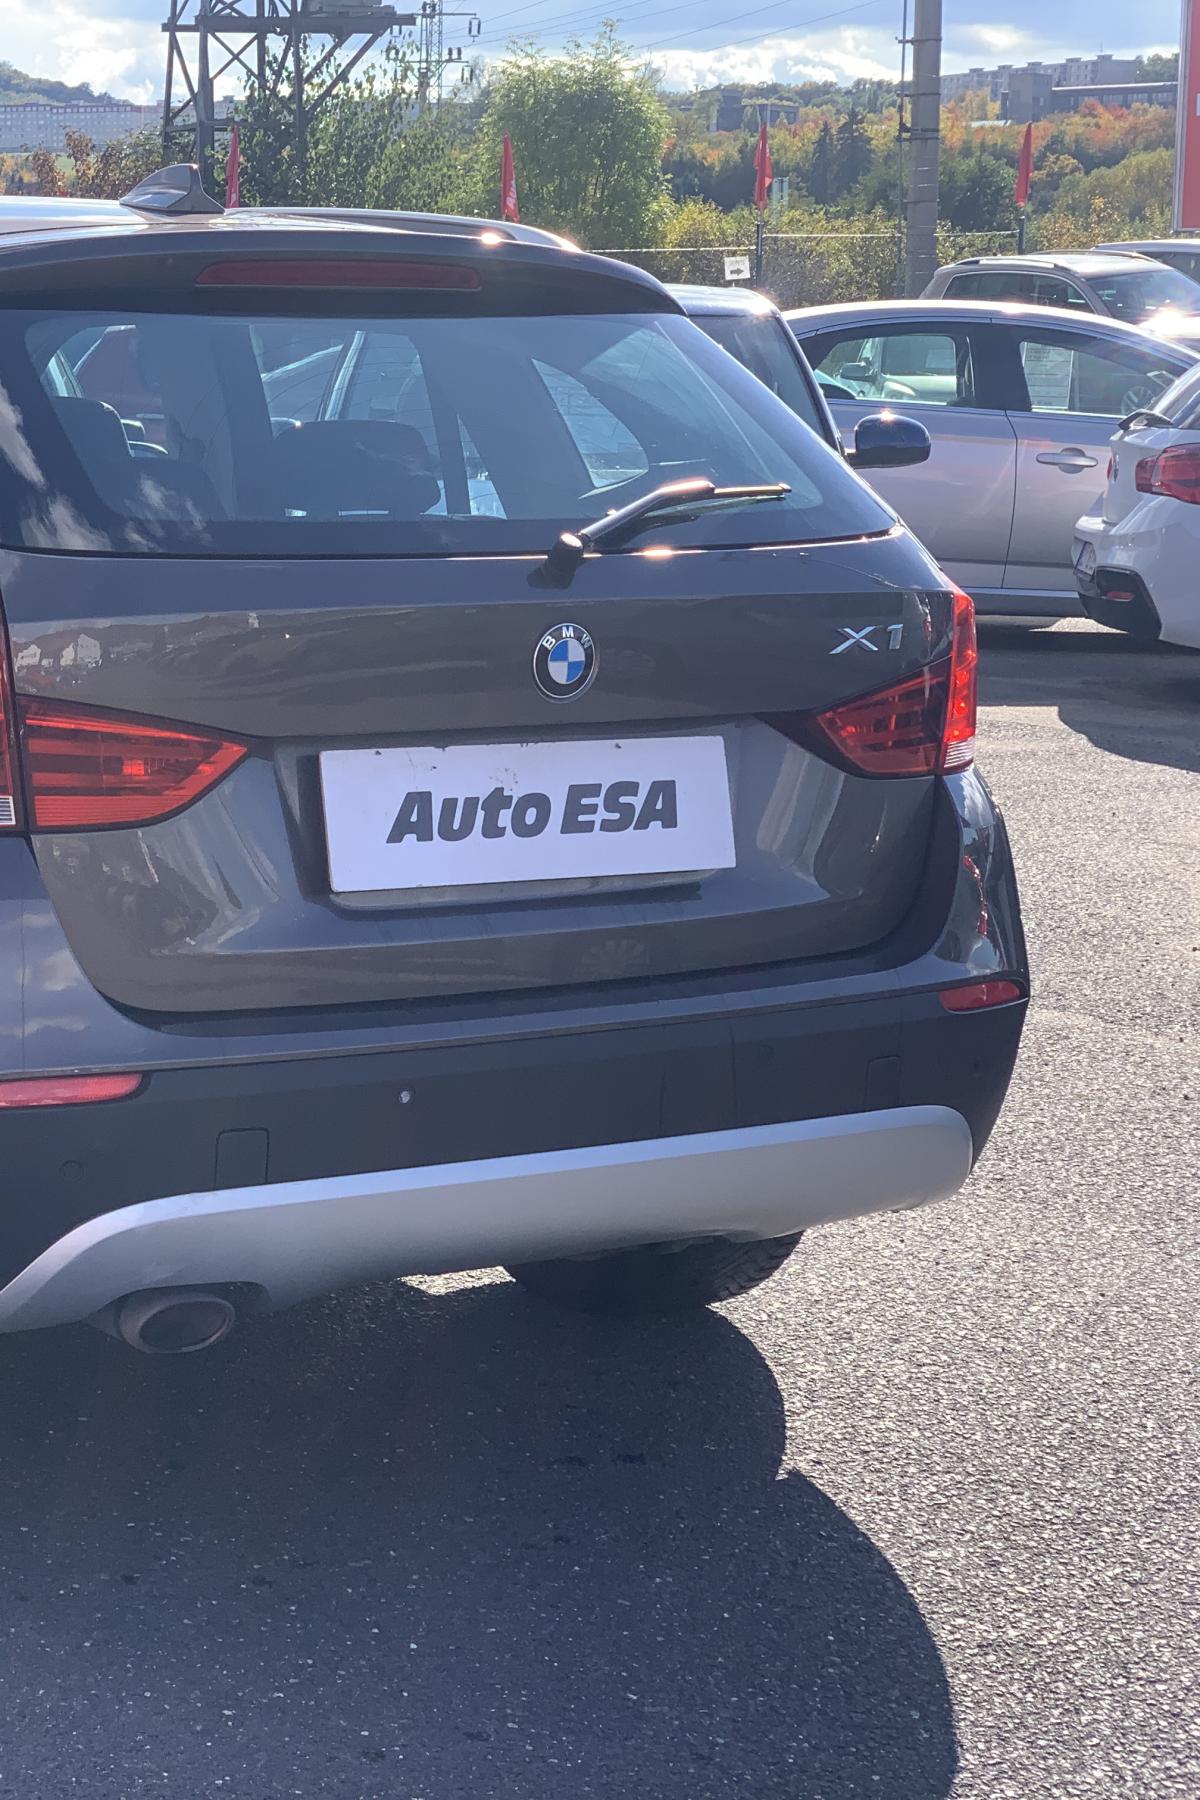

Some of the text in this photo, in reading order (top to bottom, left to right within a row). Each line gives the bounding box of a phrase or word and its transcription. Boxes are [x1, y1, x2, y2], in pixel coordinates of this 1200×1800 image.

[542, 625, 593, 651] BMW
[829, 623, 903, 655] X1
[385, 779, 678, 843] Auto ESA
